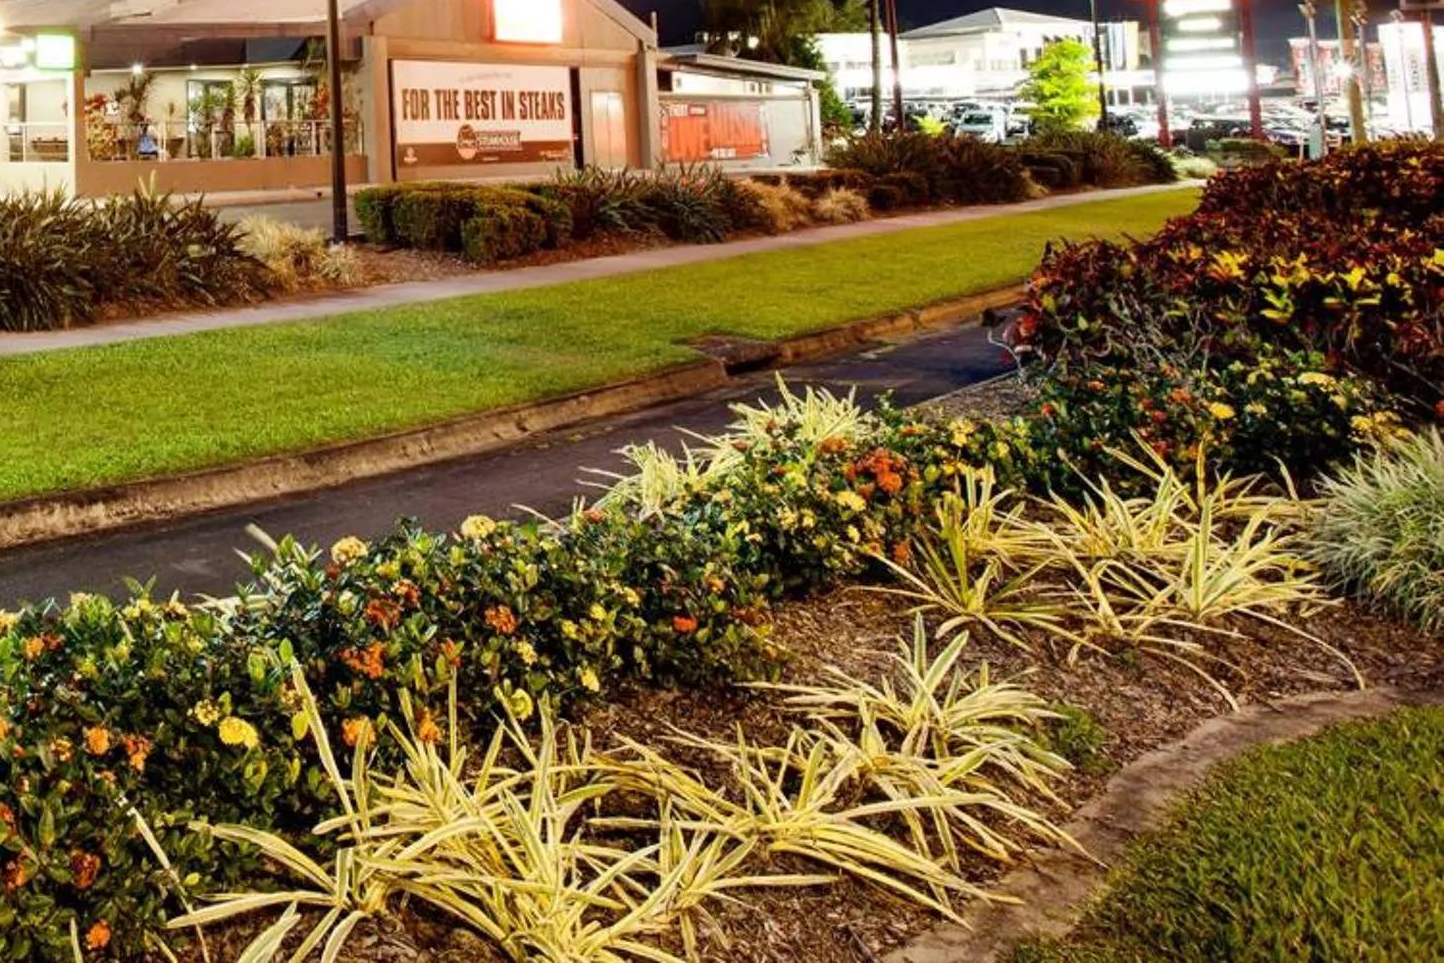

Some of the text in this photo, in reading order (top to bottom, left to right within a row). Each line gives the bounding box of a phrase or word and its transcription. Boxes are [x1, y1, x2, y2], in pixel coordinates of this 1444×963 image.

[402, 88, 566, 121] FOR THE BEST IN STEAKS
